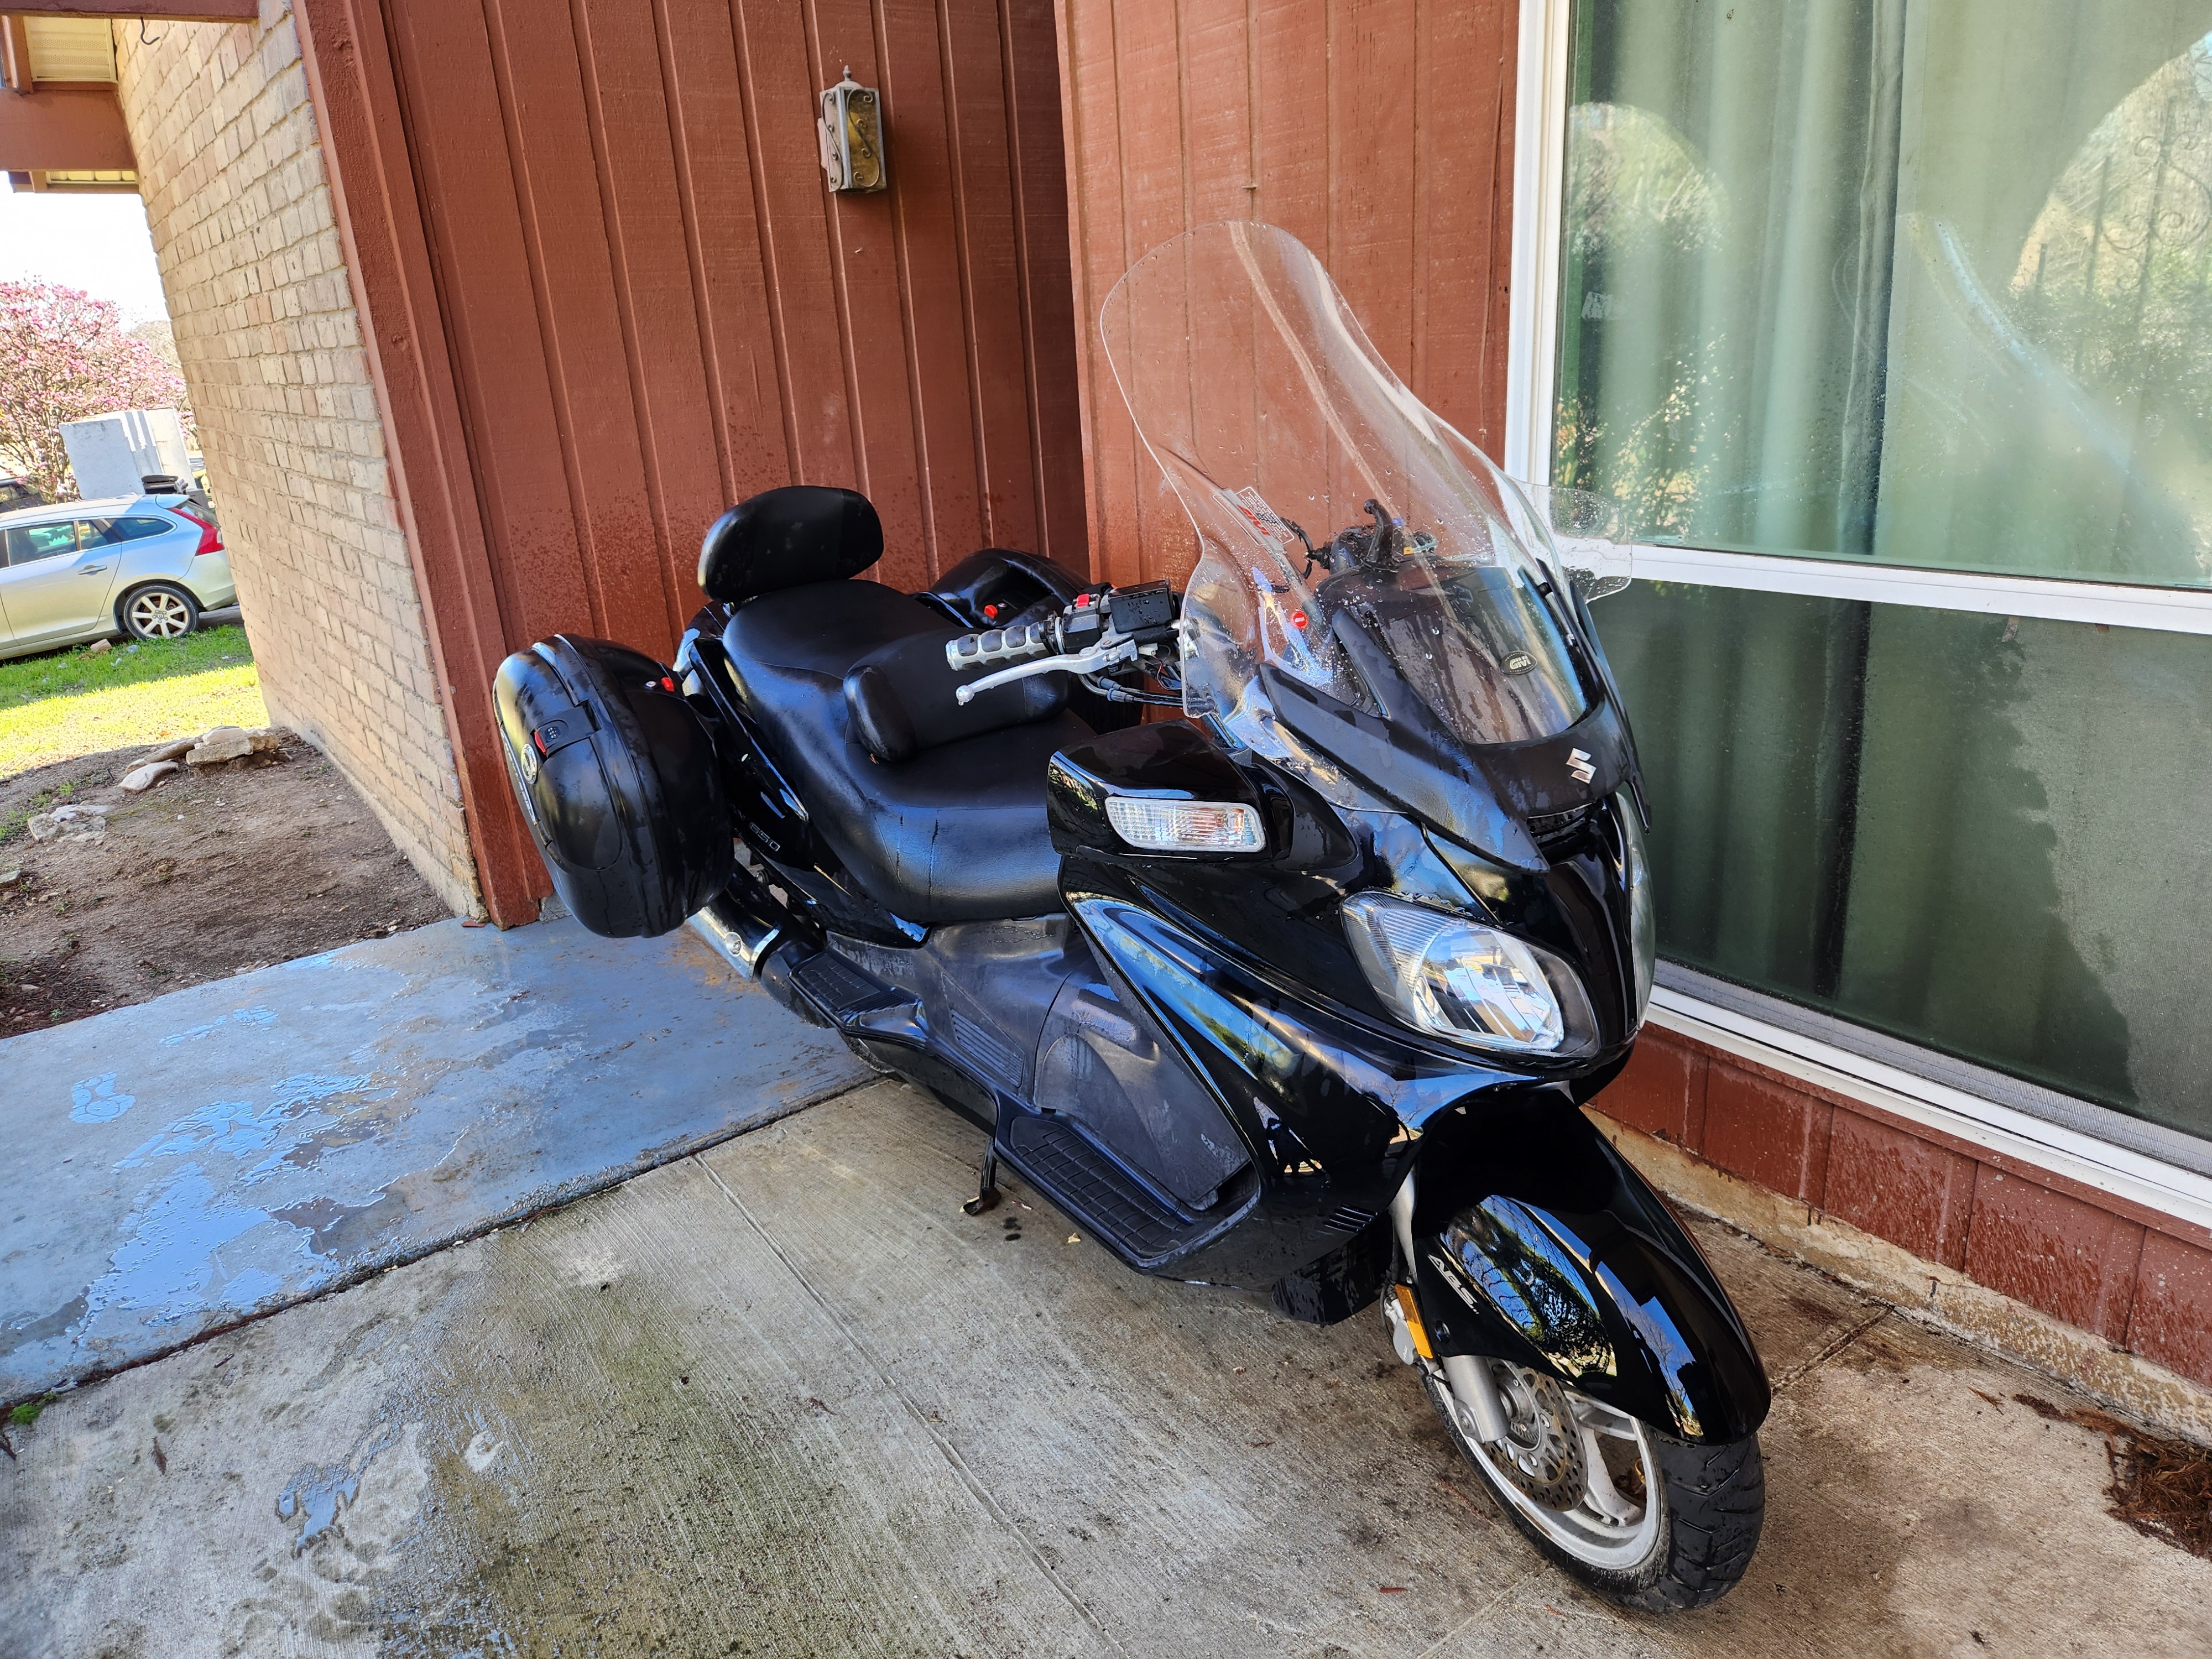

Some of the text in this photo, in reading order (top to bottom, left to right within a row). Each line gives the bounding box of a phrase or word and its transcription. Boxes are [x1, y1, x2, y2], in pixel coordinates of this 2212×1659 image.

[1510, 655, 1531, 670] GIVI
[749, 822, 781, 852] 650
[1428, 1254, 1478, 1306] ABS
